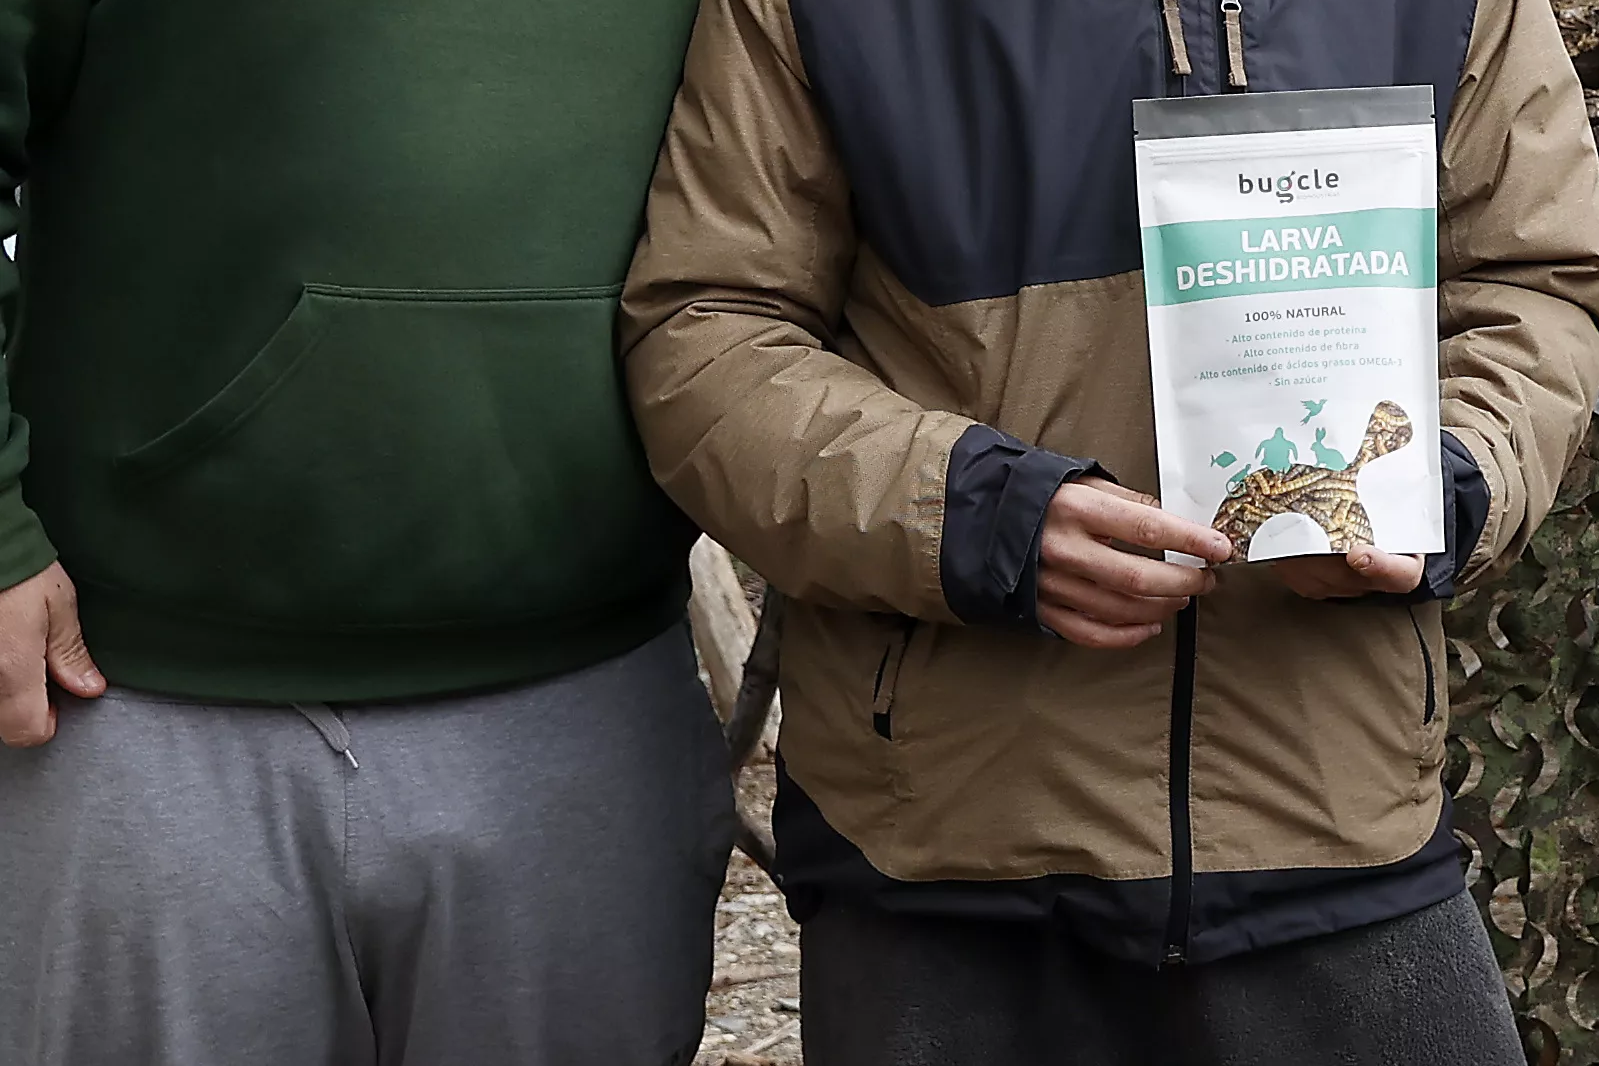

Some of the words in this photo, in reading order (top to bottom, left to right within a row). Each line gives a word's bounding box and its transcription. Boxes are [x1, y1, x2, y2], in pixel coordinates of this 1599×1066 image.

[1238, 169, 1339, 203] bugcle
[1240, 225, 1343, 253] LARVA
[1176, 251, 1409, 291] DESHIDRATADA
[1244, 311, 1282, 323] 100%
[1286, 306, 1346, 319] NATURAL
[1231, 334, 1252, 344] Alto
[1255, 329, 1305, 341] contenido
[1308, 328, 1320, 336] de
[1243, 349, 1264, 359] Alto
[1266, 343, 1317, 356] contenido
[1320, 342, 1332, 351] de
[1335, 341, 1360, 351] fibra
[1199, 370, 1219, 381] Alto
[1222, 364, 1268, 378] contenido
[1271, 362, 1283, 371] de
[1286, 358, 1319, 369] ácidos
[1322, 358, 1356, 369] grasos
[1274, 377, 1290, 387] Sin
[1293, 373, 1328, 385] azúcar
